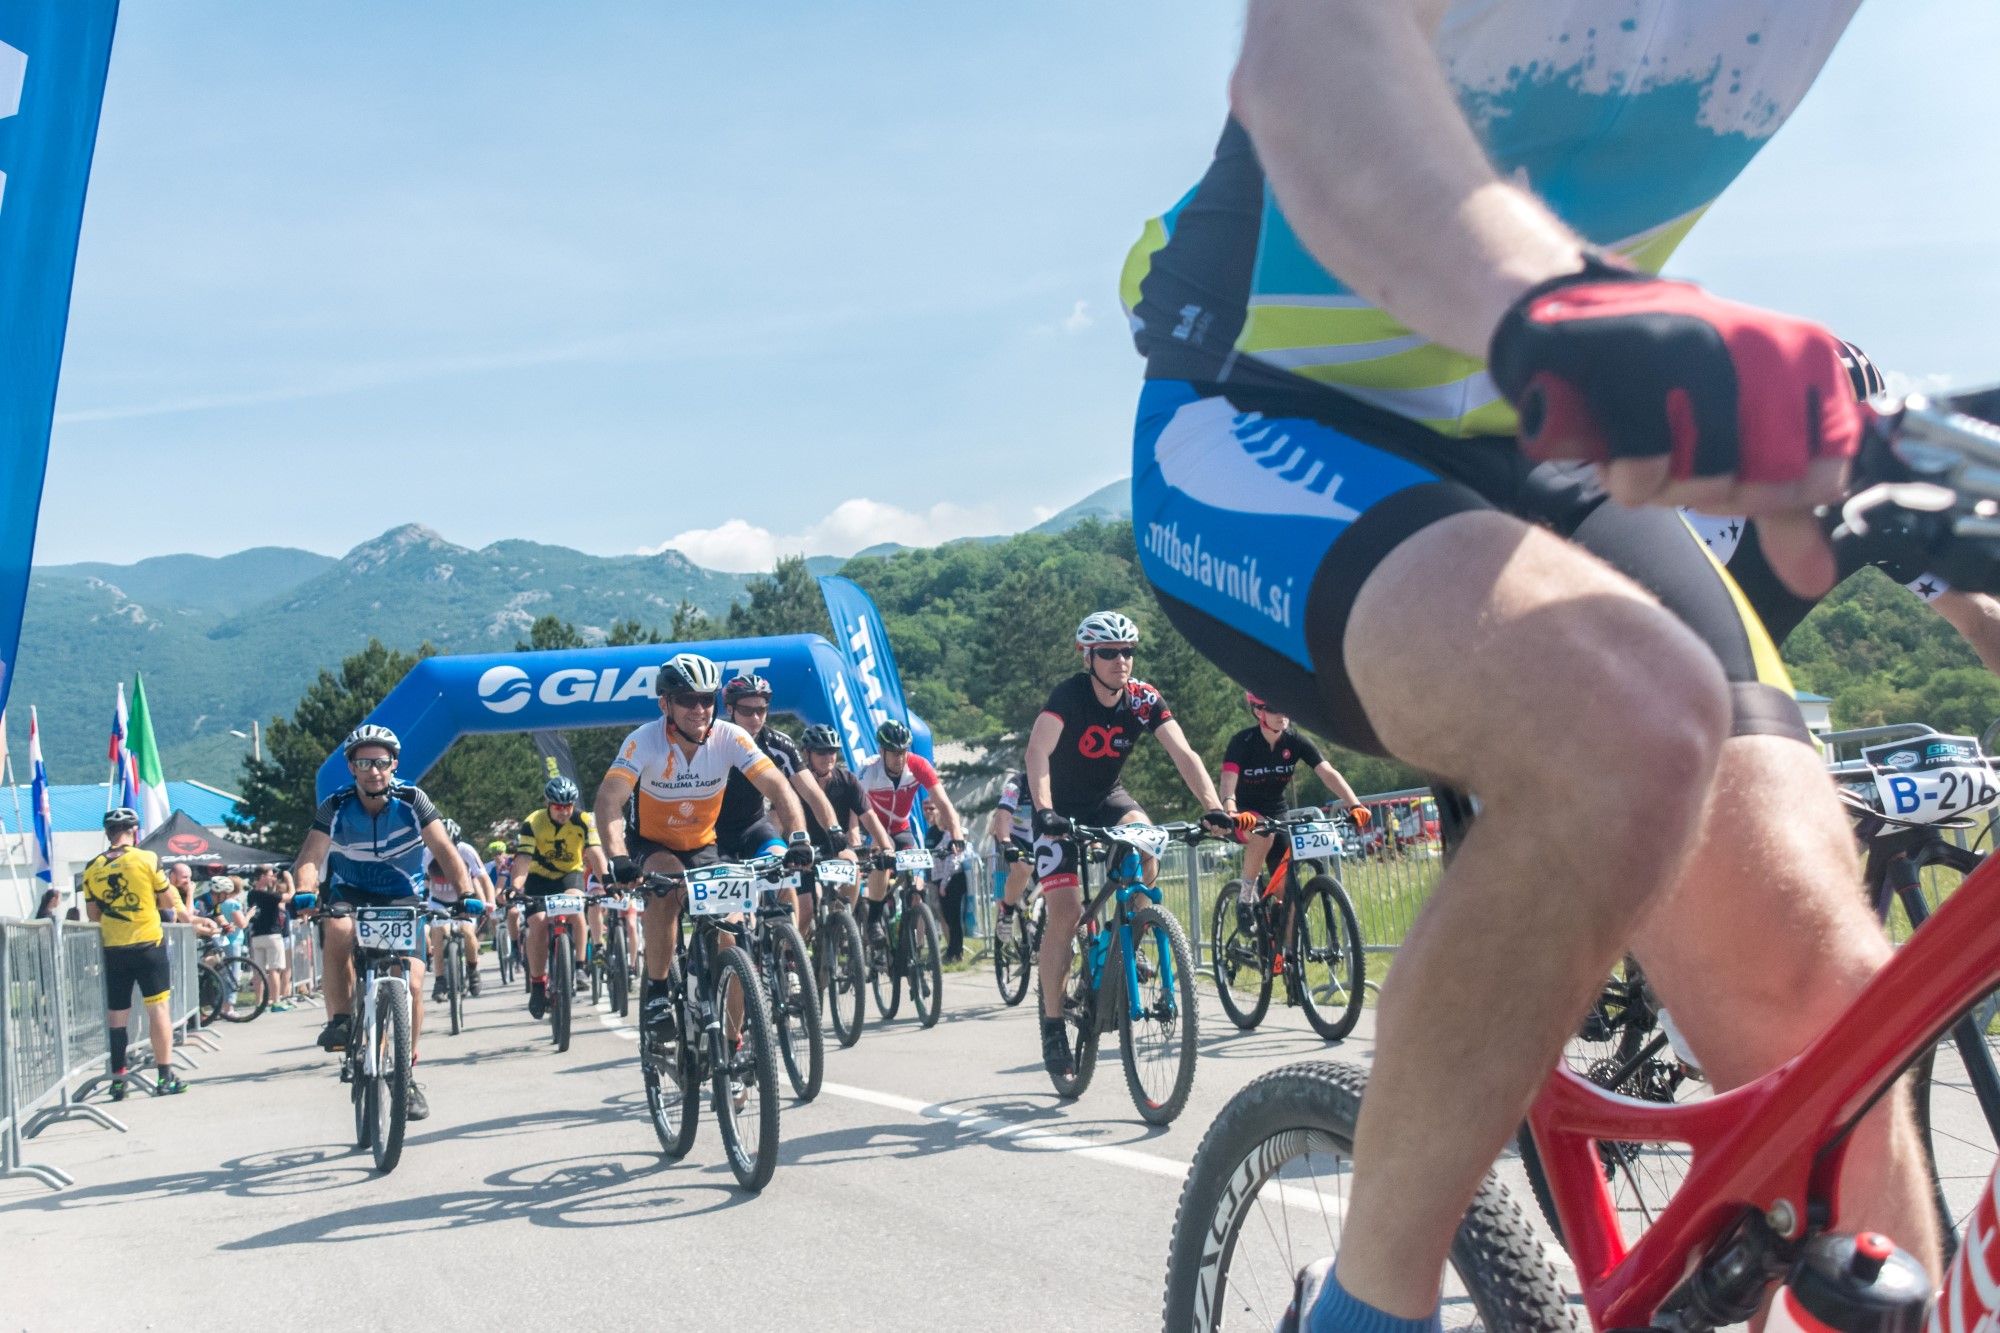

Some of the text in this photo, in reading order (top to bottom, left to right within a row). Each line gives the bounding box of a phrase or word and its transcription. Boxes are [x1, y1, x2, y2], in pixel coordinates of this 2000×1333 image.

[539, 657, 771, 705] GIAT
[677, 772, 700, 781] ŠKOLA
[1888, 771, 1997, 815] B-216
[693, 880, 750, 901] B-241
[360, 921, 412, 938] B-203
